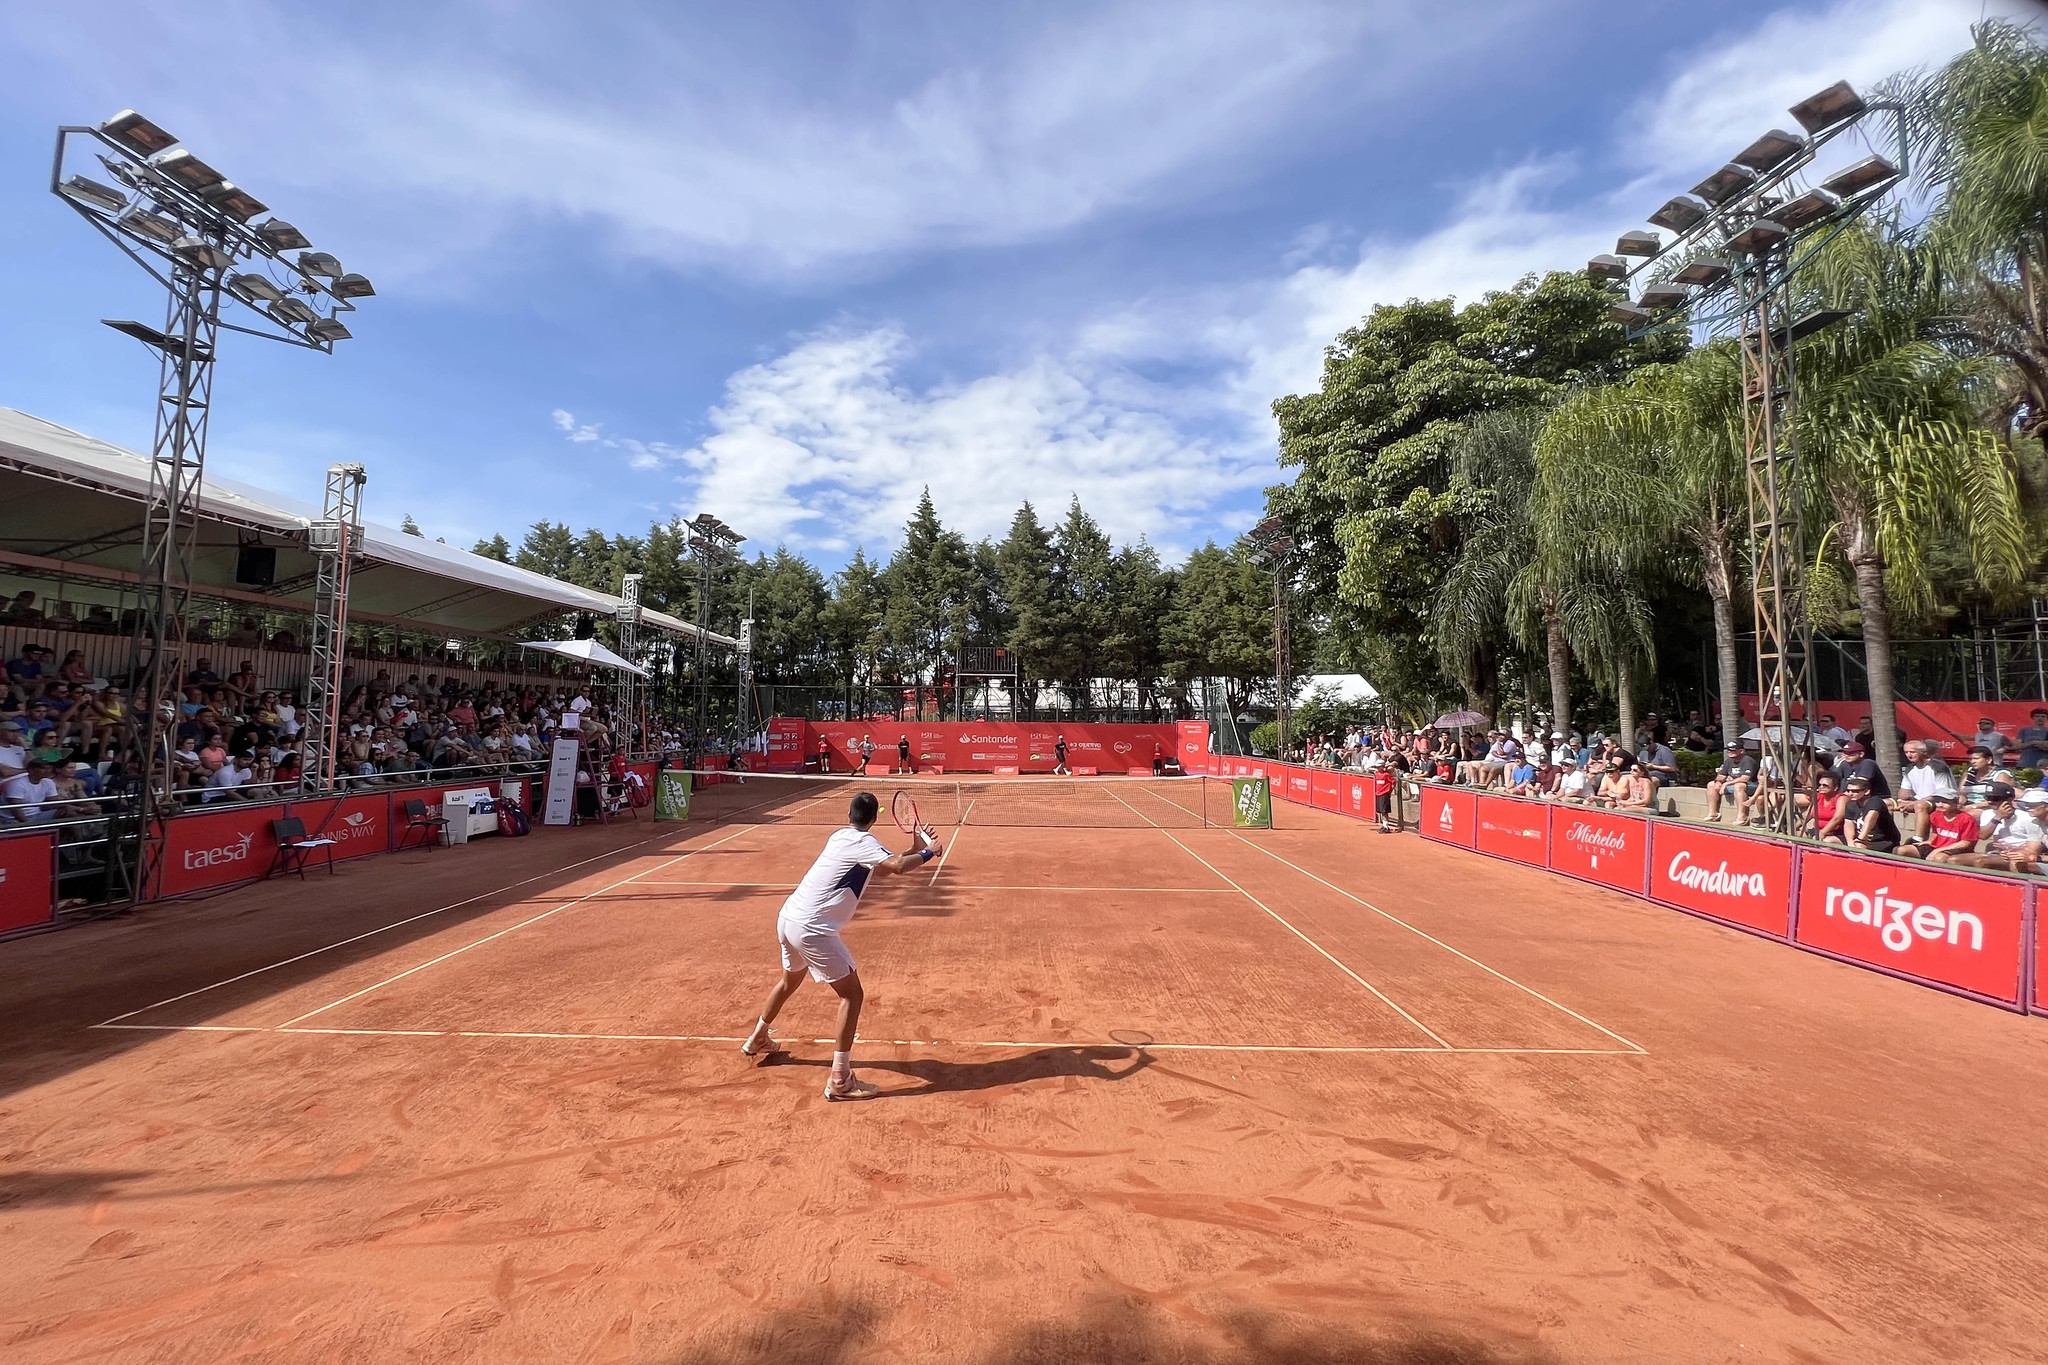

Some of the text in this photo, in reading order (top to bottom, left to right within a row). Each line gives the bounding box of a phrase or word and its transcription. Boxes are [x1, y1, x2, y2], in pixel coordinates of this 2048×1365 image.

[971, 733, 1018, 744] Santander
[661, 795, 671, 814] TOUR
[662, 774, 679, 818] CHALLENGER
[671, 780, 686, 808] ATP
[1237, 783, 1252, 815] ATP
[1244, 781, 1262, 825] CHALLENGER
[1252, 801, 1262, 821] TOUR
[351, 825, 376, 839] WAY
[1566, 821, 1625, 850] Michelob
[183, 841, 249, 870] taesa
[1576, 843, 1615, 858] ULTRA
[1668, 850, 1766, 897] Candura
[1825, 886, 1984, 952] raízen
